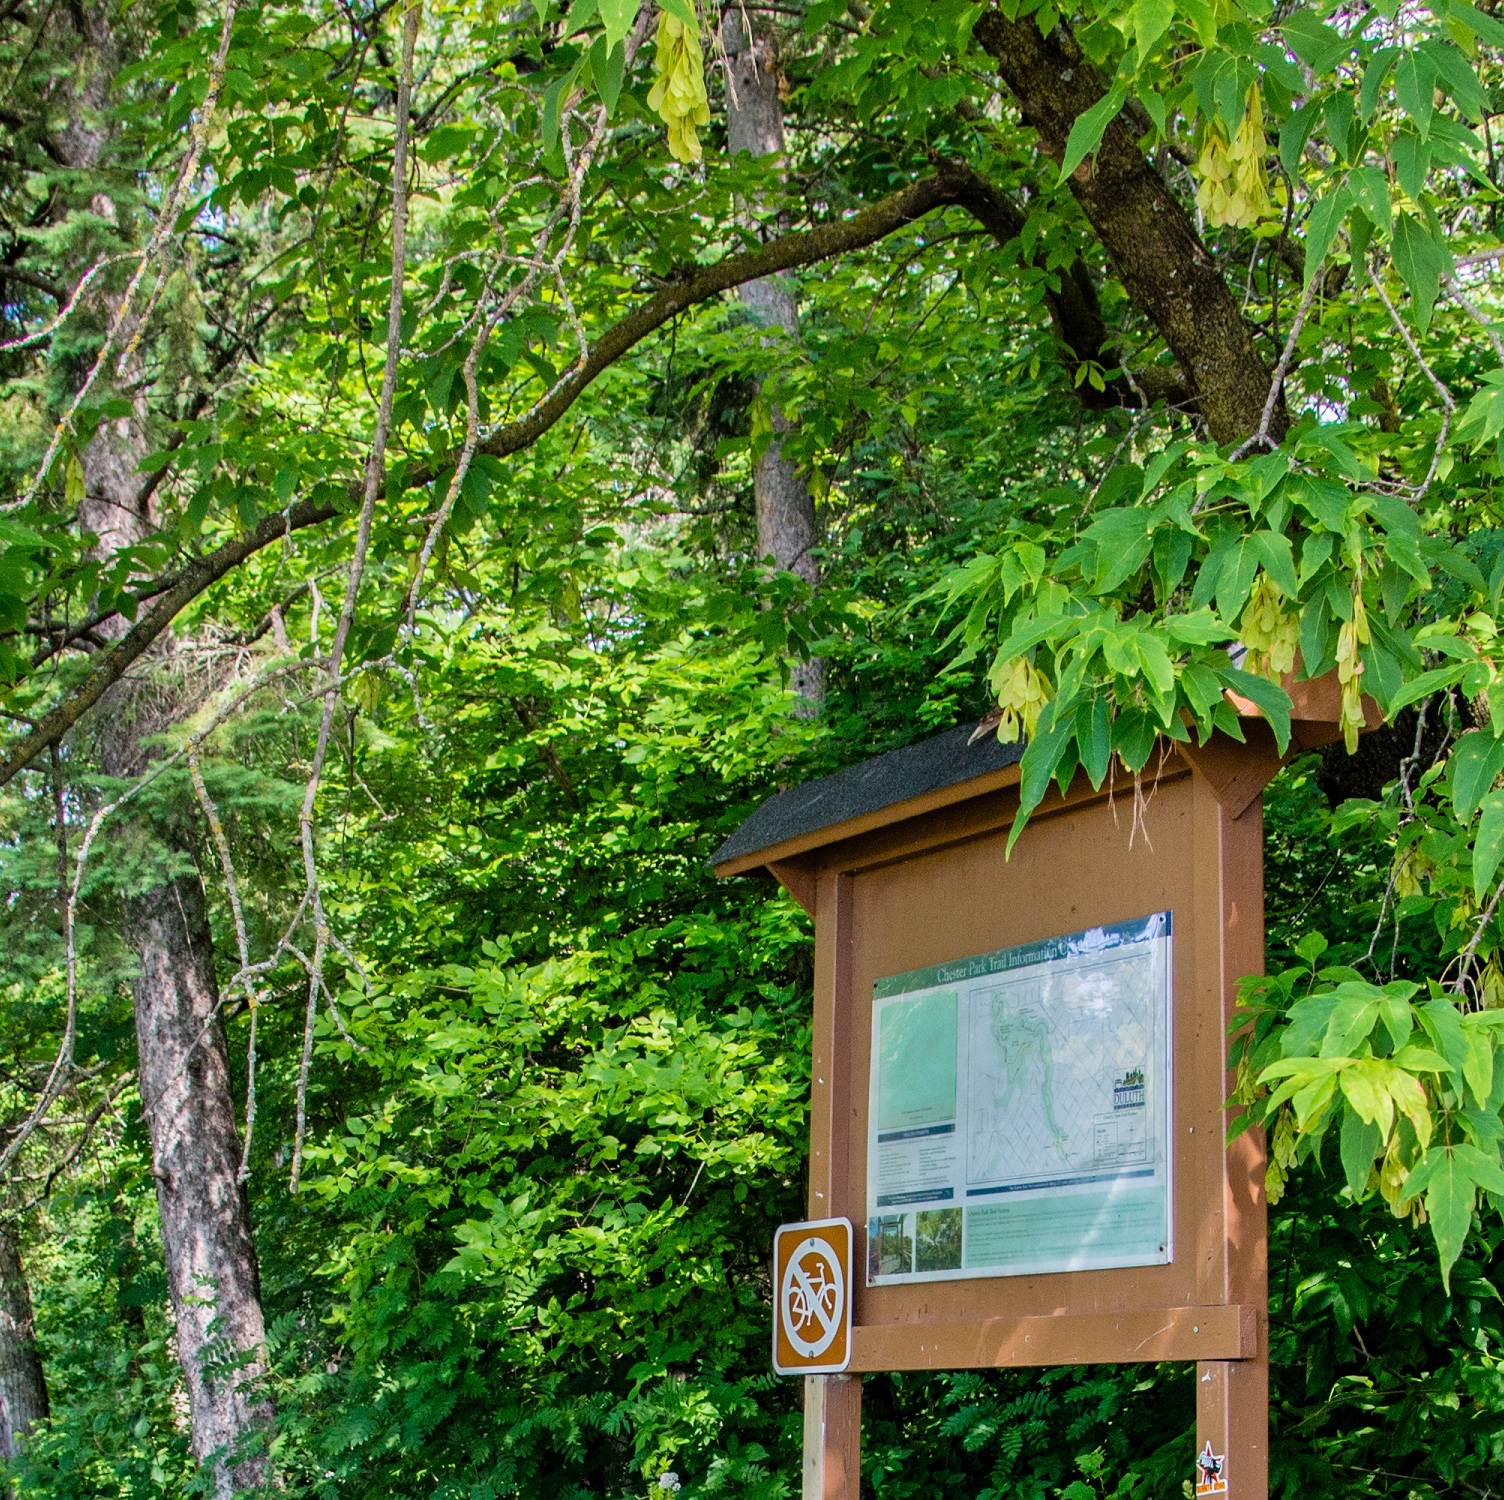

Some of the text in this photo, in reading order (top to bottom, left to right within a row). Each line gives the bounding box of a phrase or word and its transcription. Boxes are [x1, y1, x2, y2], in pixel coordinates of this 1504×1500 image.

[937, 967, 967, 983] Chester
[969, 961, 987, 975] Park
[989, 953, 1007, 972] Trail
[1009, 945, 1058, 967] Information
[1114, 1090, 1144, 1104] DULUTH
